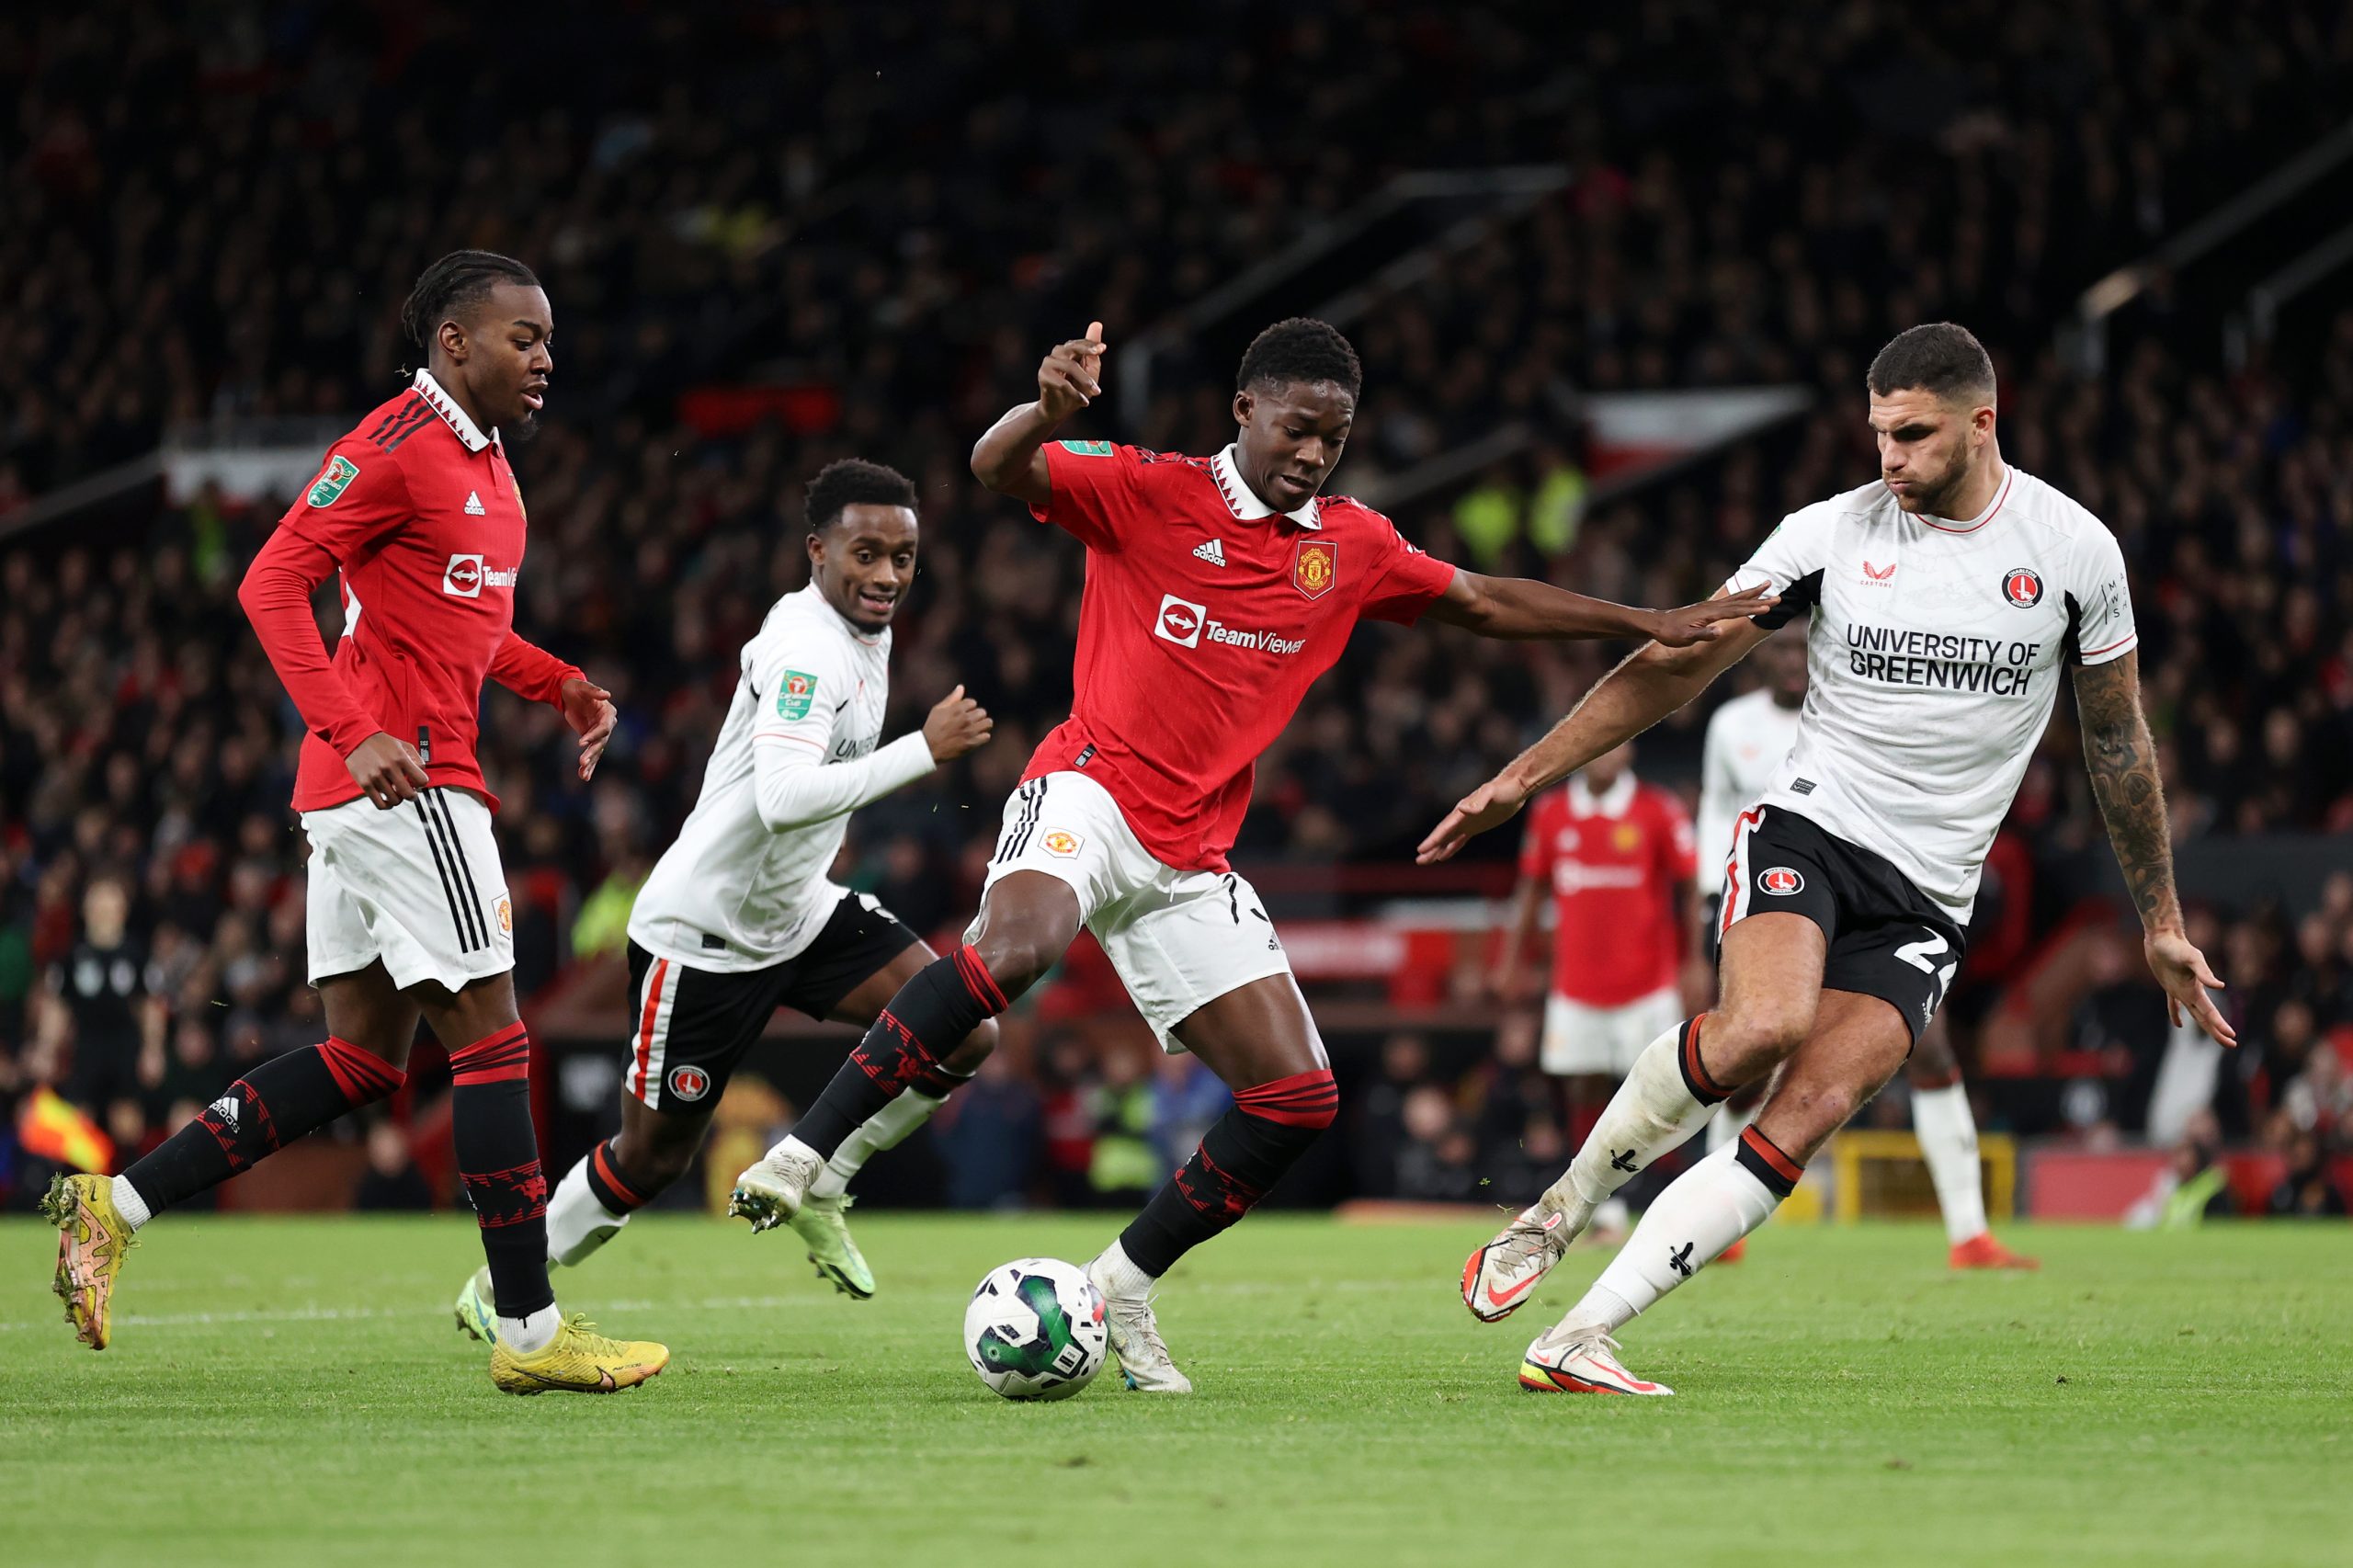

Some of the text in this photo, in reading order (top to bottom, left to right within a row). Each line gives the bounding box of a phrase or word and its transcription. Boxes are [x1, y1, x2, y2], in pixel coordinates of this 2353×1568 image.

[463, 506, 485, 516] adidas
[1192, 548, 1227, 567] adidas
[2007, 568, 2038, 579] CHARLTON
[1304, 579, 1324, 588] UNITED
[1859, 579, 1893, 588] CASTORE
[2009, 599, 2035, 608] ATHLETIC
[1206, 619, 1305, 654] TeamViewer
[1847, 623, 2040, 666] UNIVERSITY OF
[1850, 650, 2033, 696] GREENWICH
